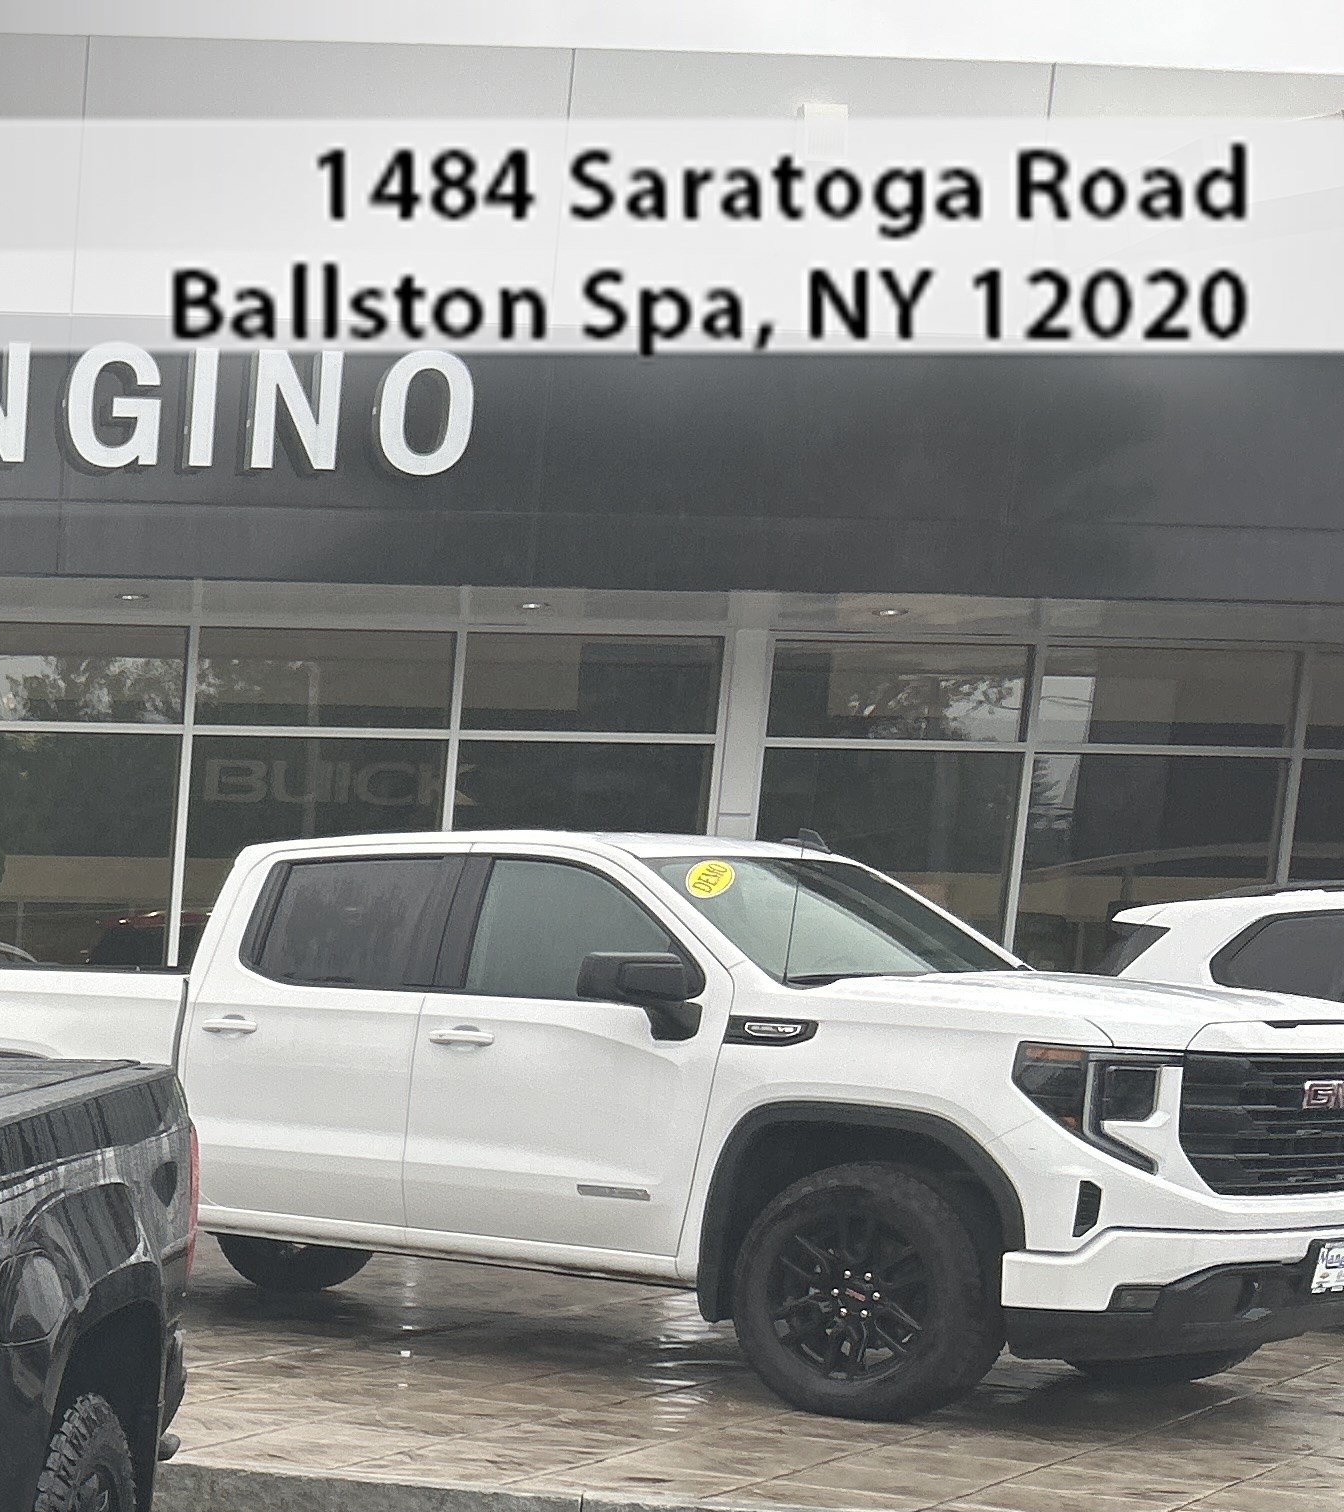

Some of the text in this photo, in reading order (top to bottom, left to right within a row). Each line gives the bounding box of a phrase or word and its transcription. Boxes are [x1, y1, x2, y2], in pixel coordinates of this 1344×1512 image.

[201, 757, 480, 807] BUICK
[691, 863, 729, 894] DEMO
[1303, 1080, 1344, 1109] G
